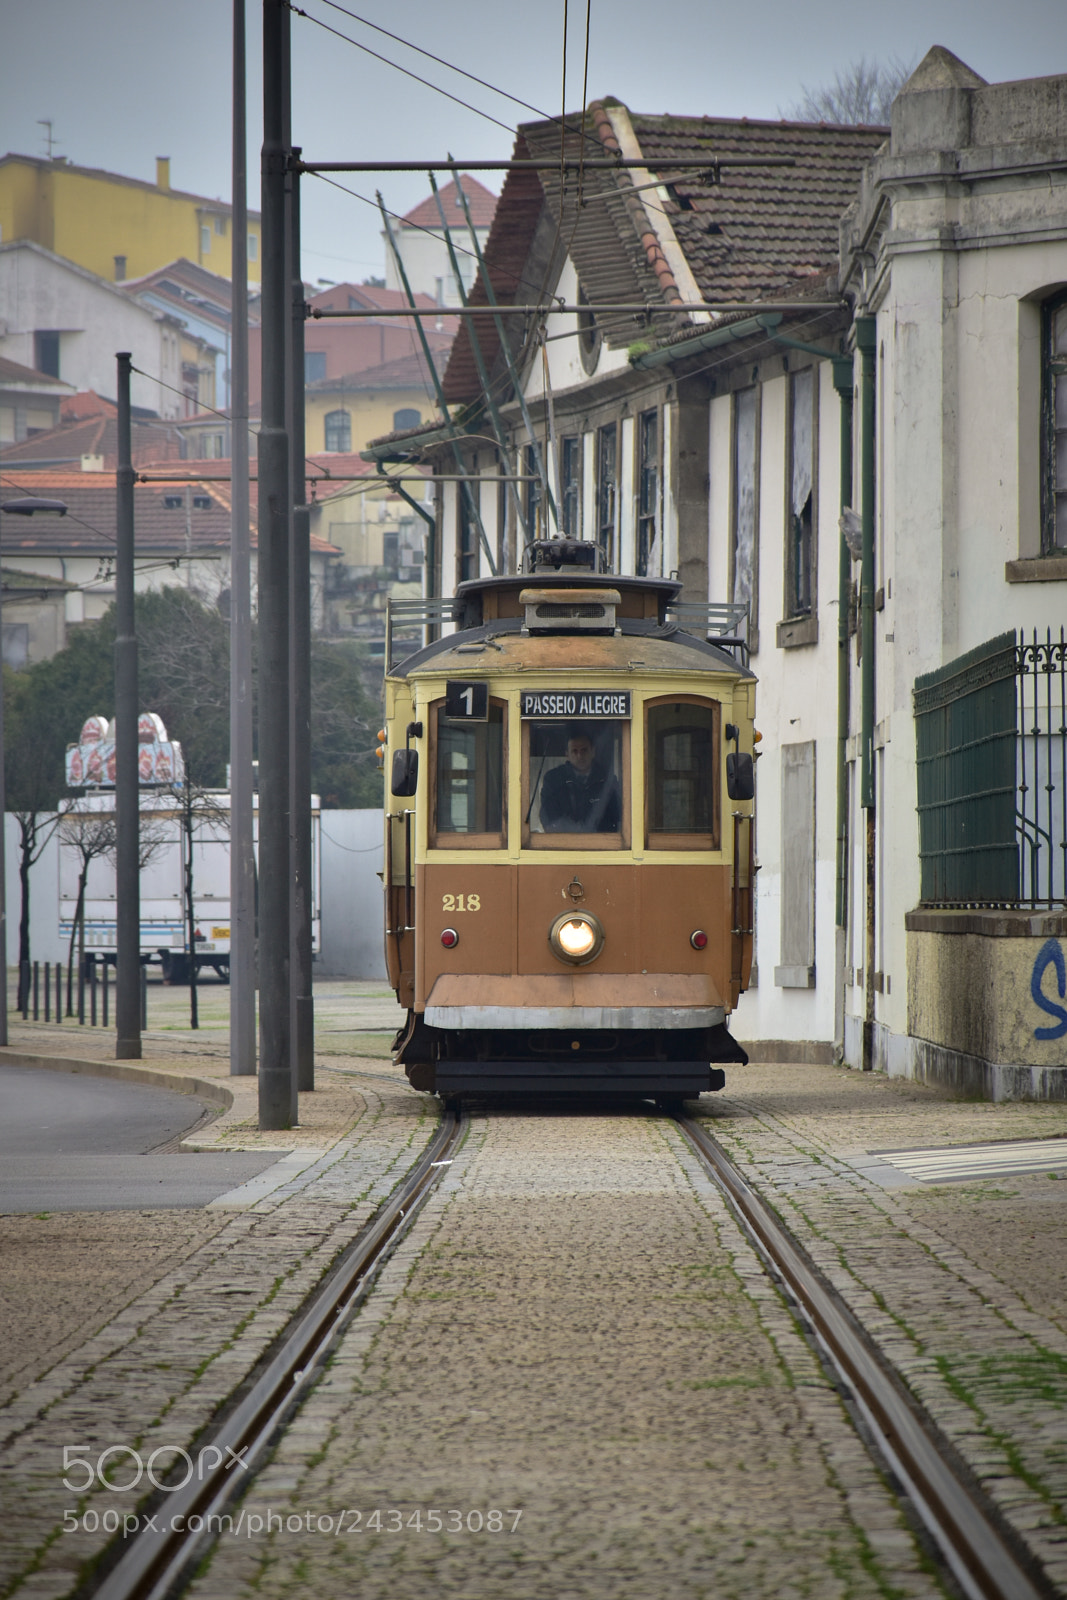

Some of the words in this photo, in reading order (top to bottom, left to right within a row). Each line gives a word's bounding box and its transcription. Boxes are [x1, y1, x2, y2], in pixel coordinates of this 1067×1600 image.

[460, 686, 474, 716] 1
[525, 695, 576, 714] PASSEIO
[580, 695, 626, 714] ALEGRE
[442, 893, 481, 912] 218
